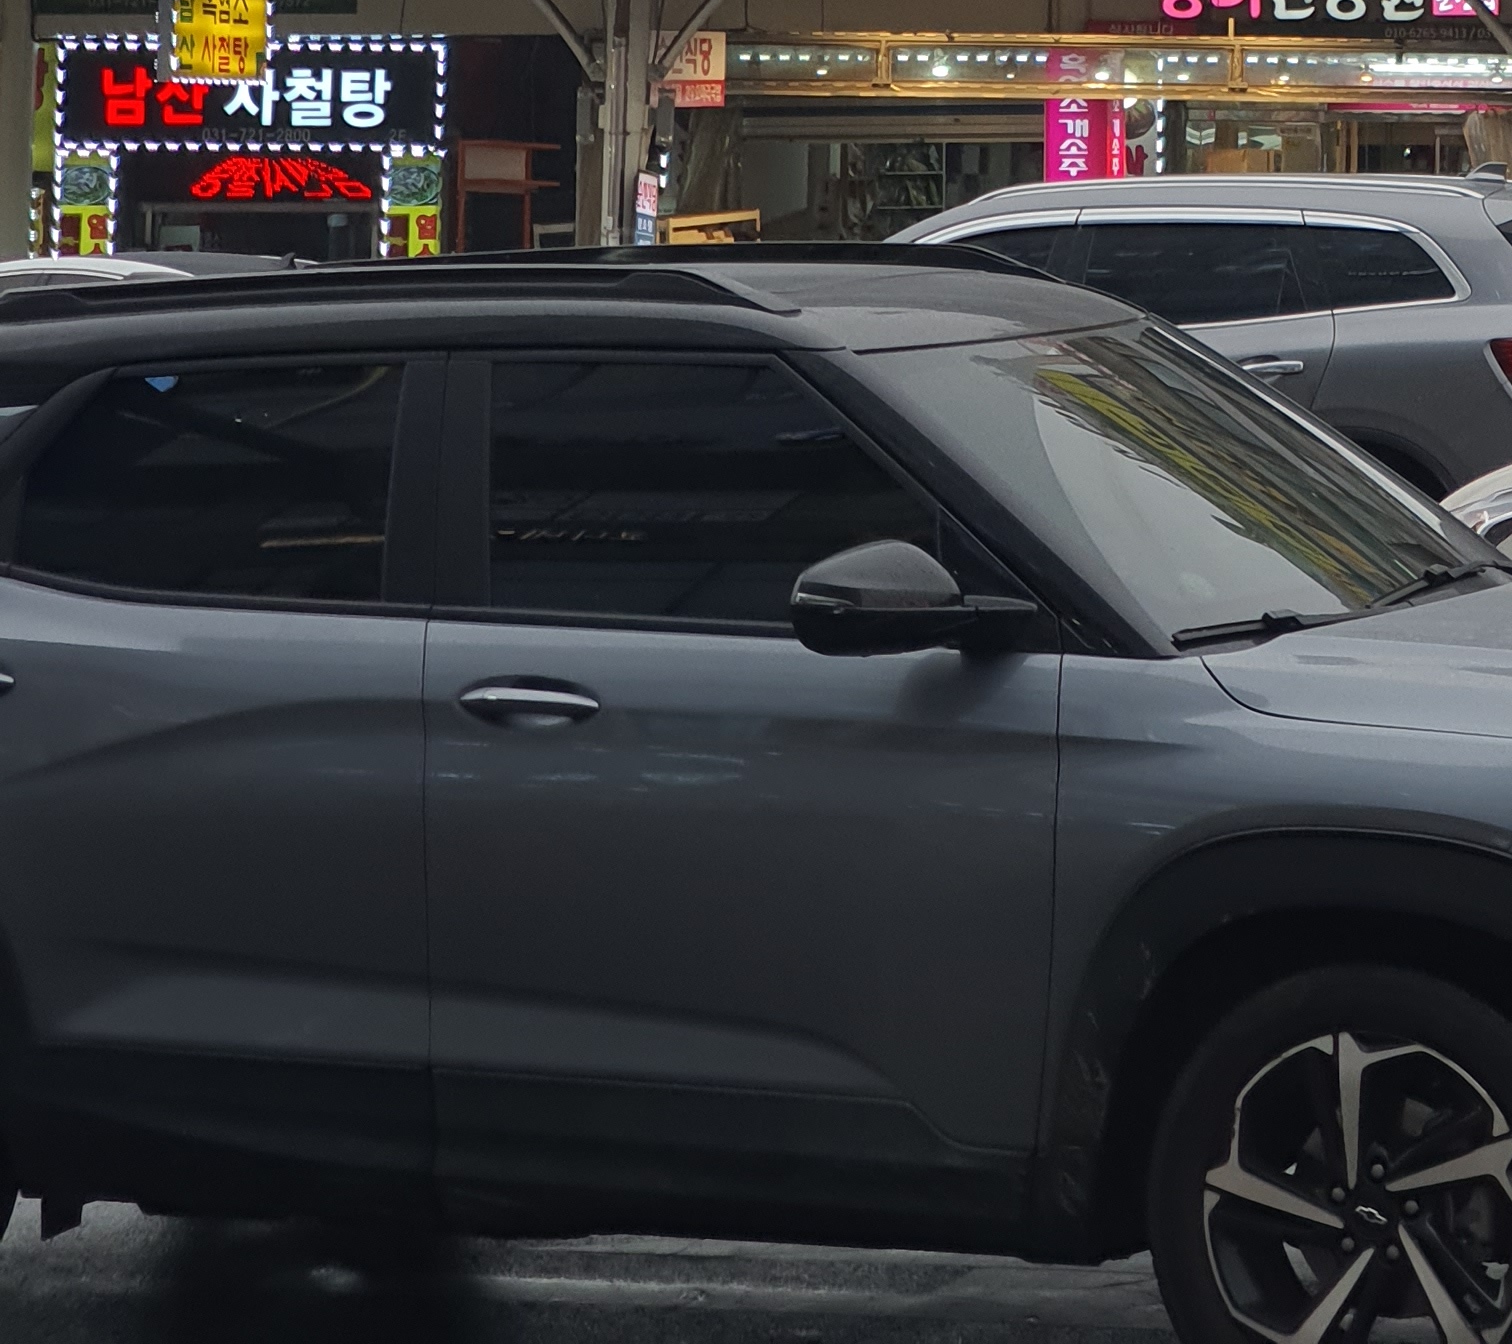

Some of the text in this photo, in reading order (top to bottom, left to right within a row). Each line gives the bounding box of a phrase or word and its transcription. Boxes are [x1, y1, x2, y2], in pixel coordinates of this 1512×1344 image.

[201, 34, 250, 74] 사철탕
[100, 66, 392, 128] 남산 사철탕
[1058, 118, 1090, 177] 개소주
